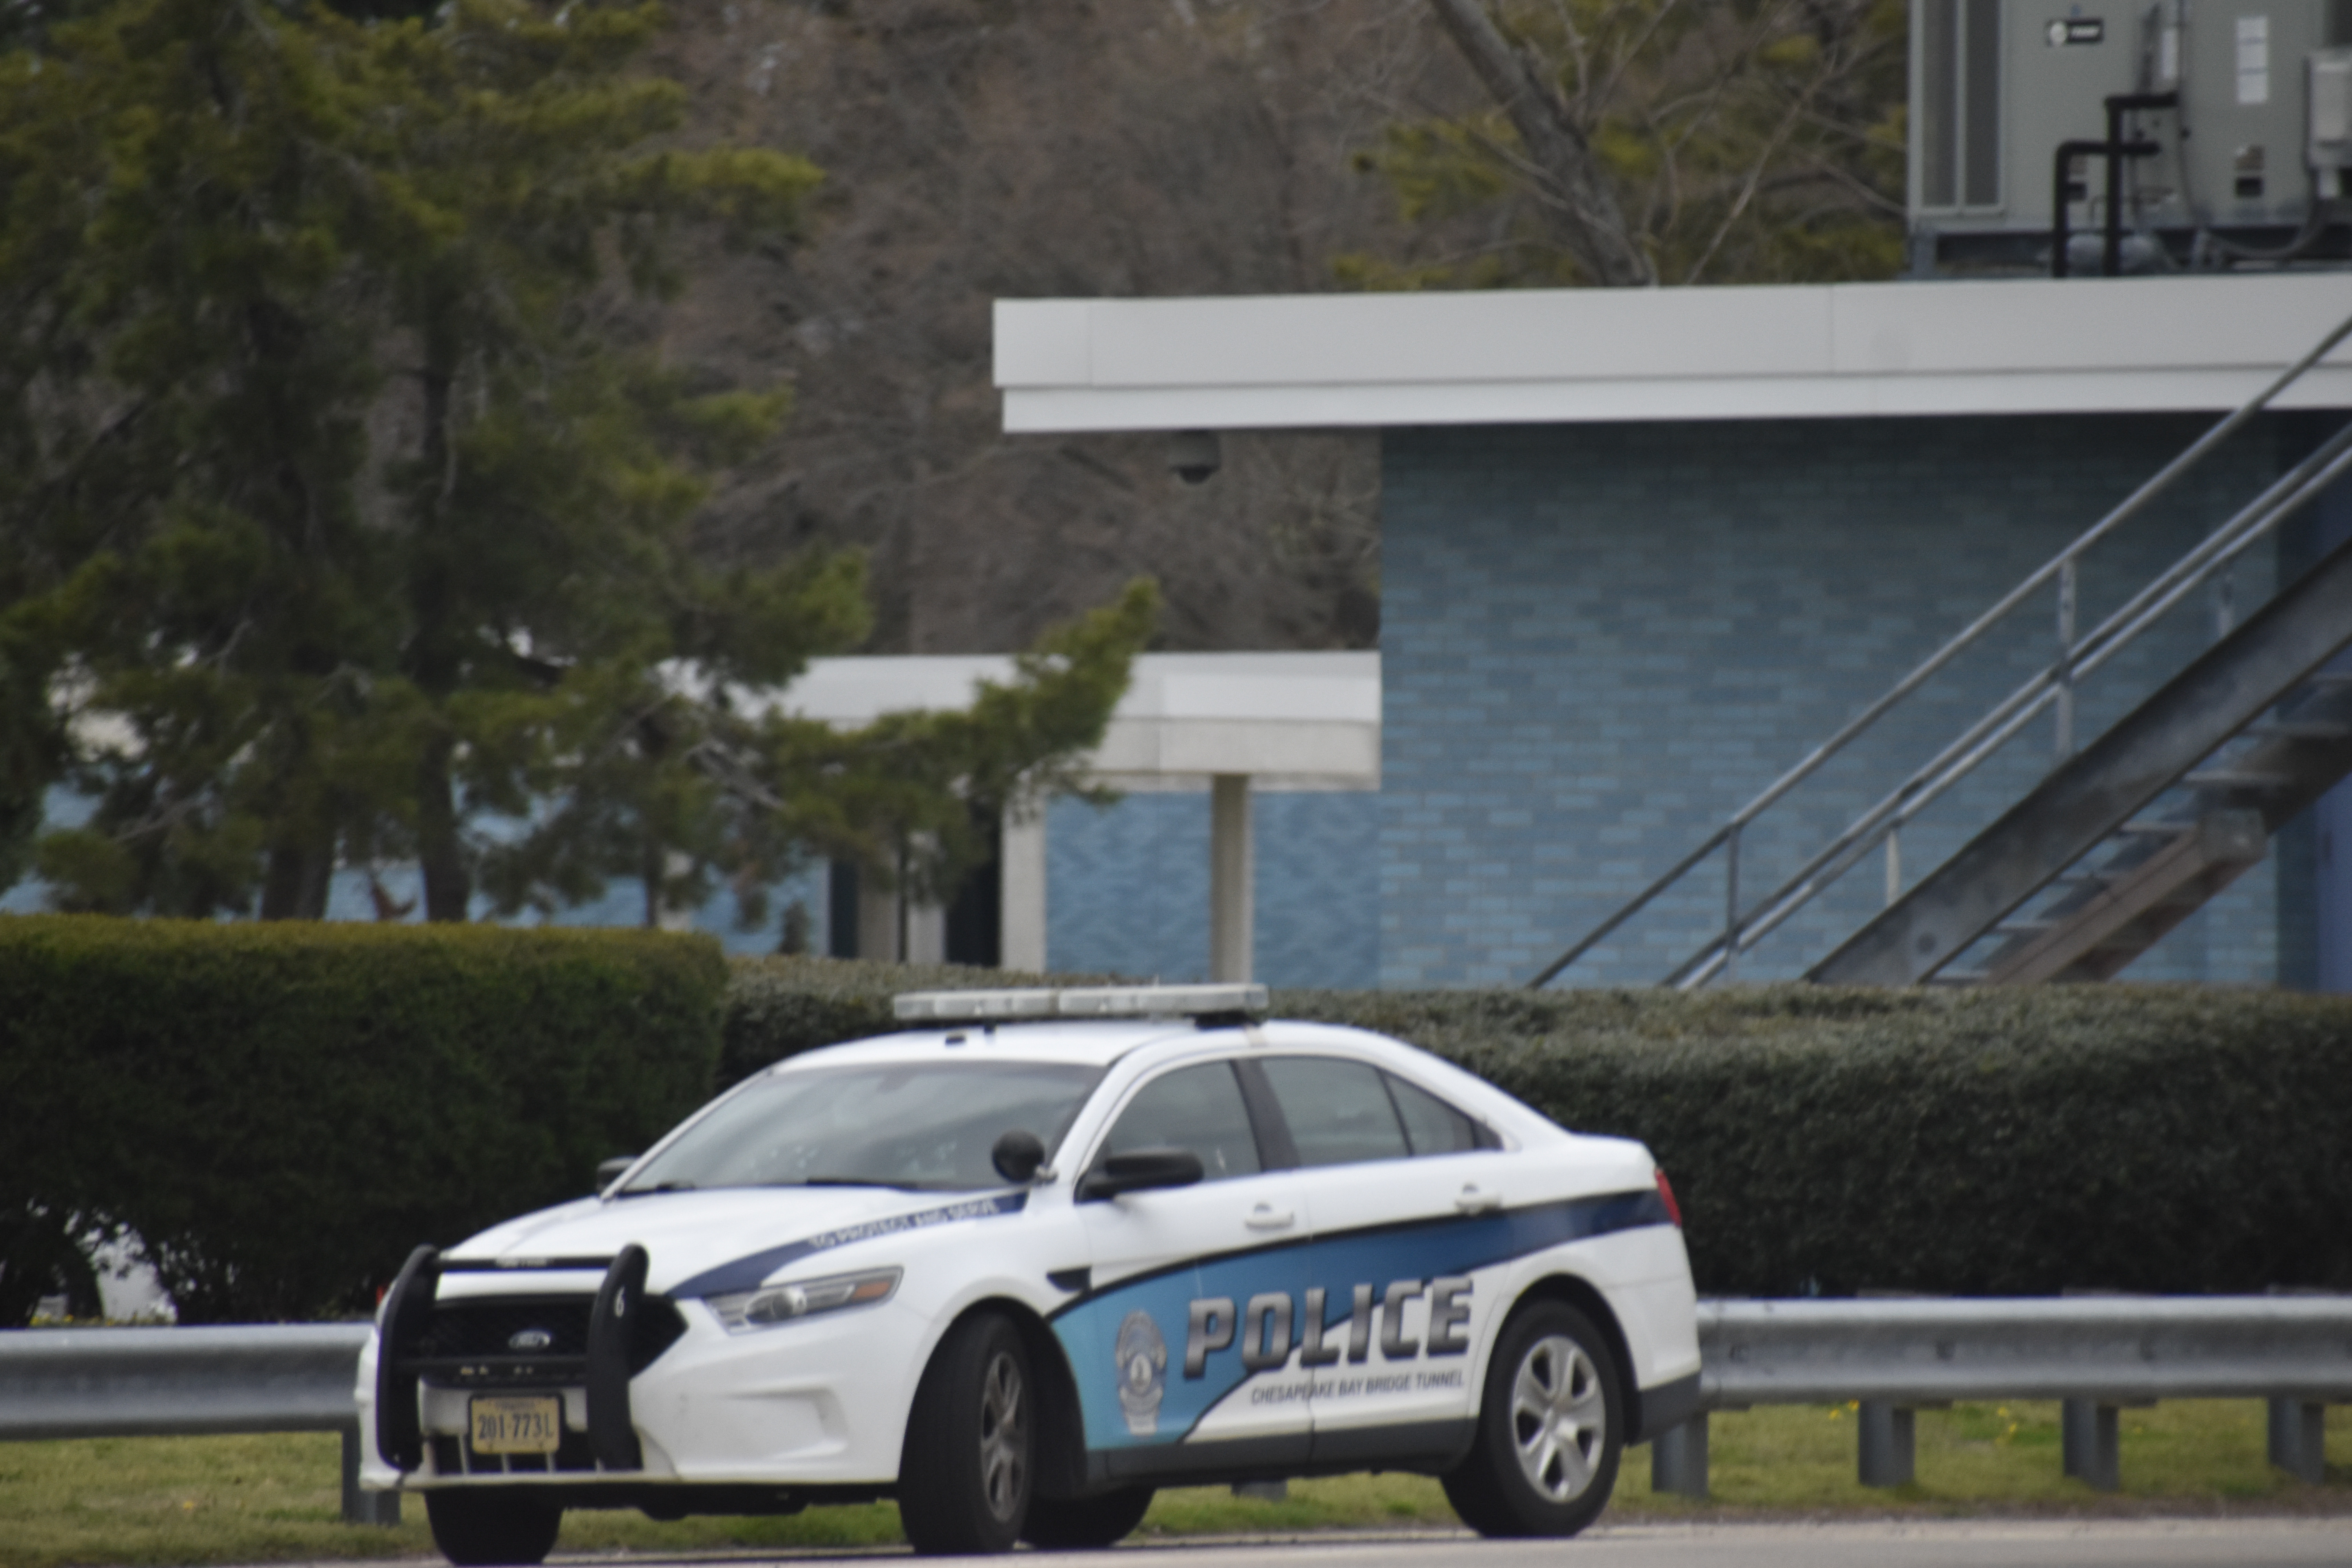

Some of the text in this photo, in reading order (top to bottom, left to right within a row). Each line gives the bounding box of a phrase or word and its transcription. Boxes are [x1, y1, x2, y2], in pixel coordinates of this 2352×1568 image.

[1183, 1276, 1473, 1380] POLICE
[1252, 1368, 1463, 1404] CHESAPEAKE BAY BRIDGE TUNNEL
